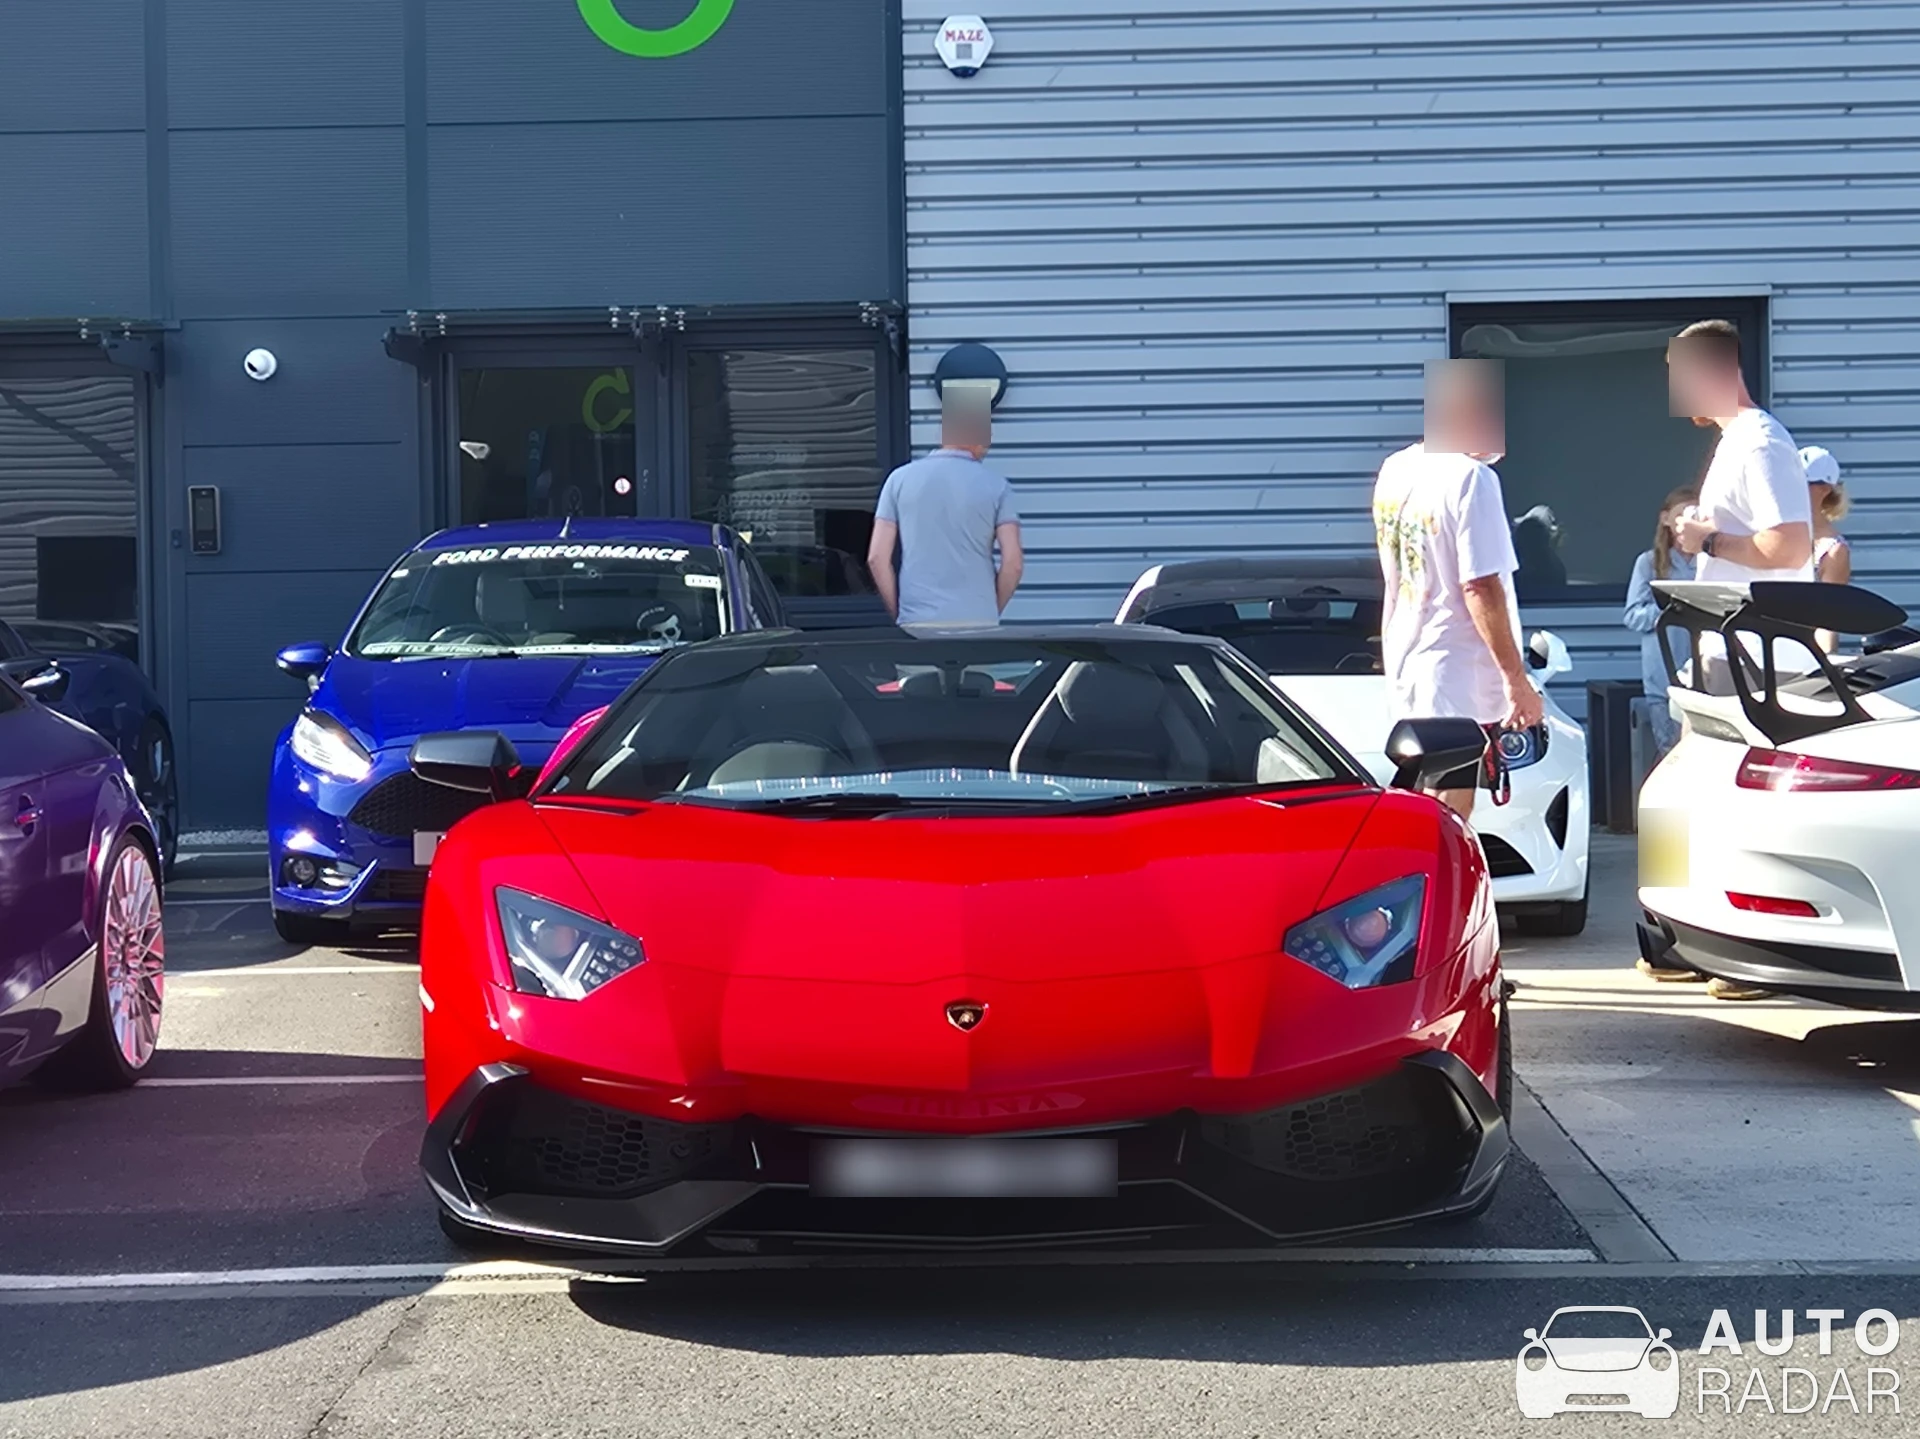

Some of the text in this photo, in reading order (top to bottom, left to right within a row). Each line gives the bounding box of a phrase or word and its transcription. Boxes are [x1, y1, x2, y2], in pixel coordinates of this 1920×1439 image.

[945, 29, 984, 42] MAZE
[432, 545, 690, 566] FORD PERFORMANCE
